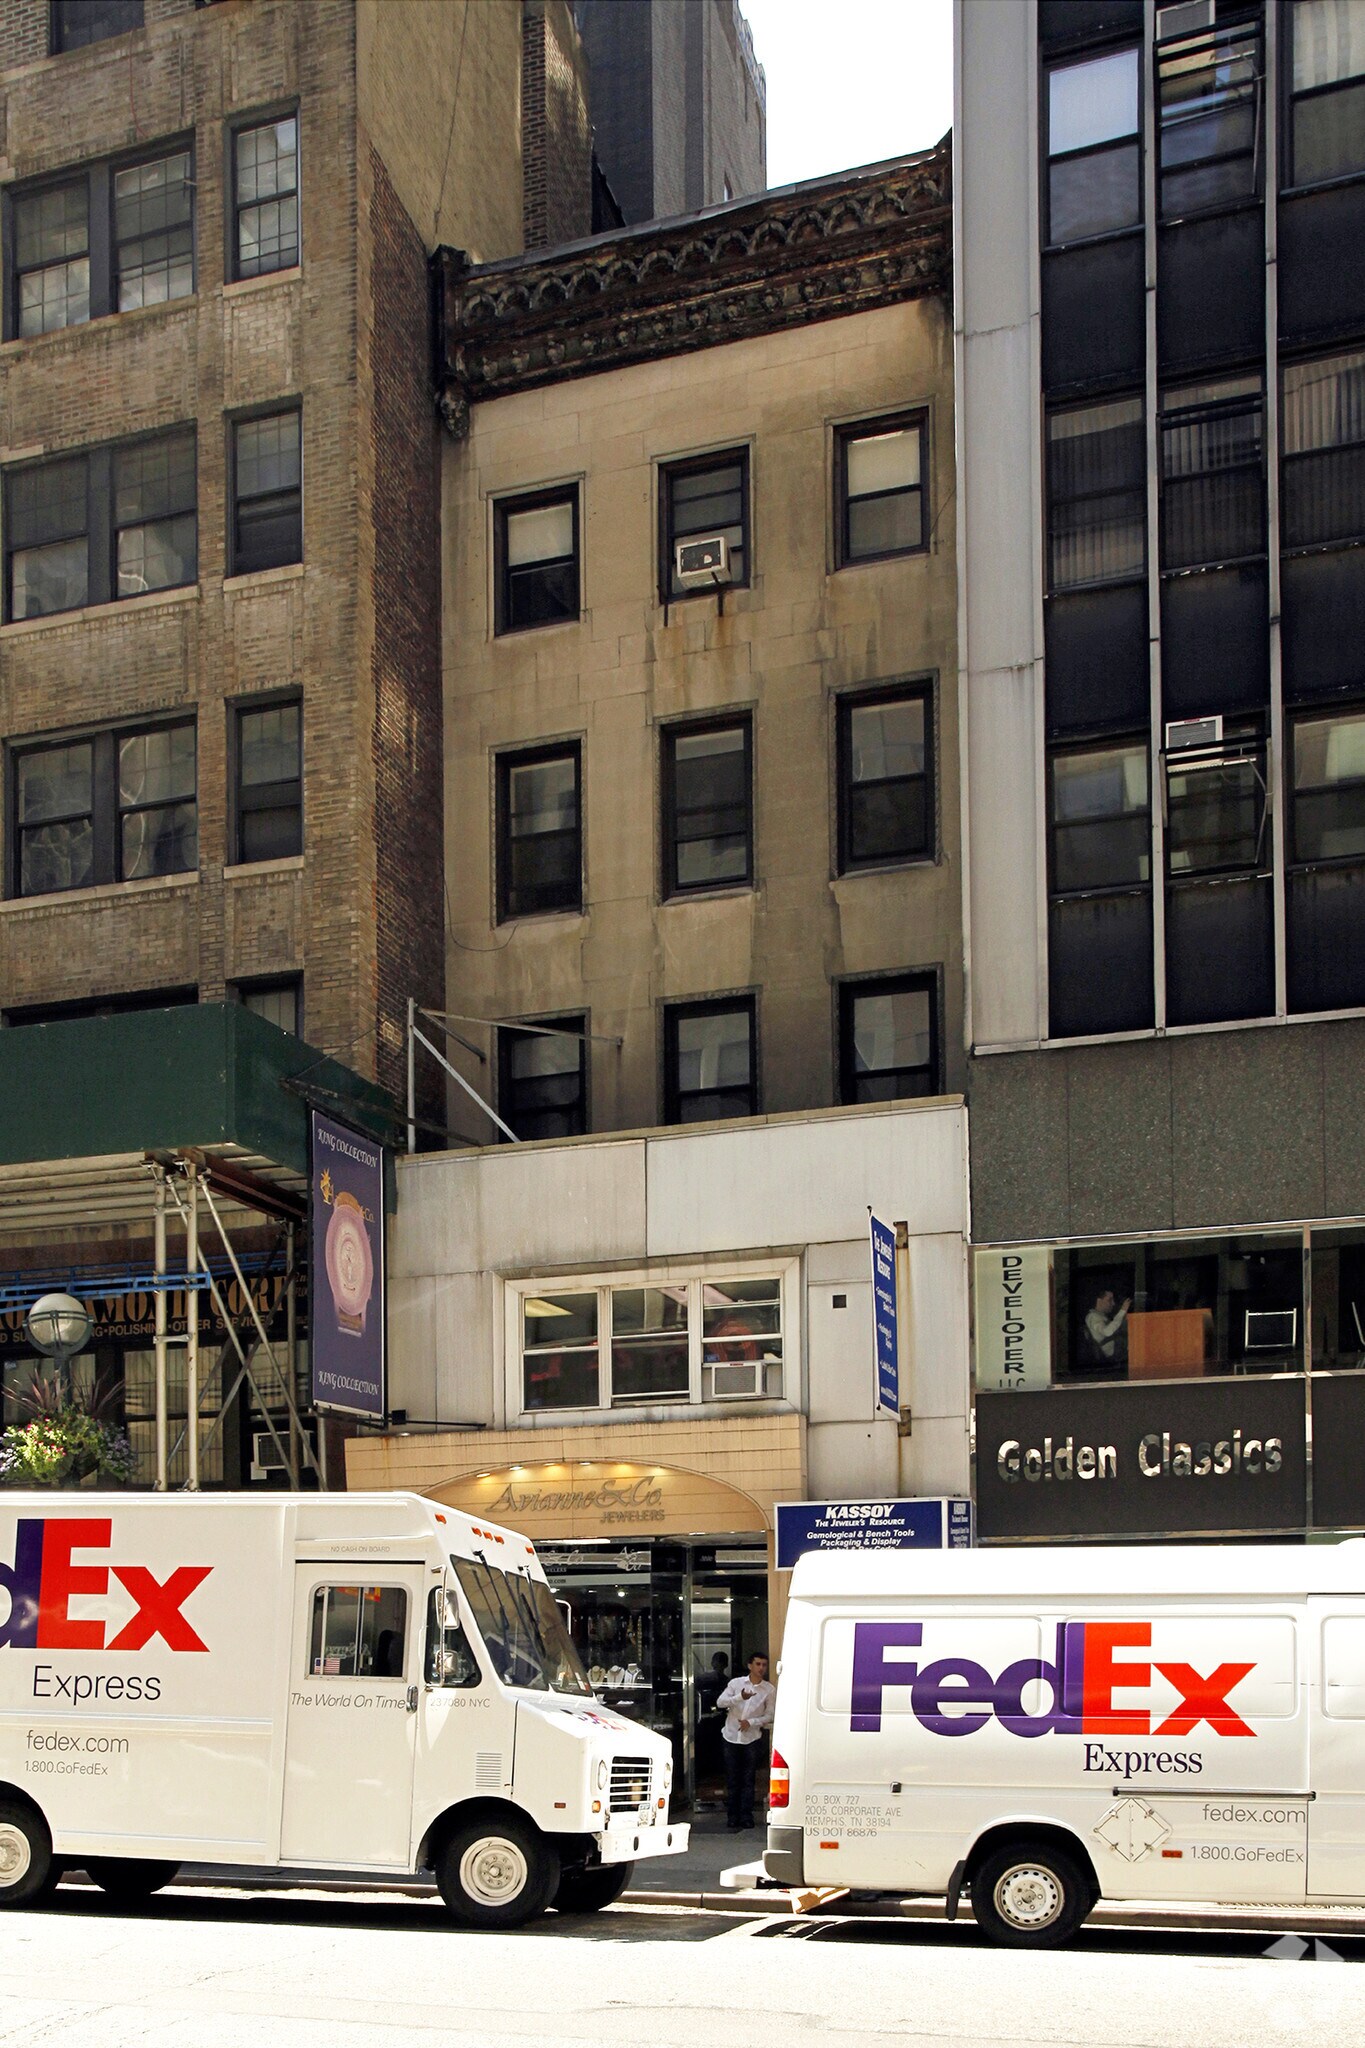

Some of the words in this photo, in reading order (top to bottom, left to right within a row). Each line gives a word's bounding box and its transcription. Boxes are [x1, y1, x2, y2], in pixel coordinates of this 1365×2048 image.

[317, 1128, 336, 1151] KING
[336, 1139, 378, 1168] COLLECTION
[1001, 1255, 1025, 1374] DEVELOPER
[108, 1325, 157, 1337] POLISHIN
[172, 1319, 211, 1333] OTER
[318, 1370, 337, 1390] KING
[337, 1375, 380, 1395] COLLECTION
[997, 1436, 1117, 1483] Golden
[1138, 1429, 1282, 1478] Classics
[600, 1509, 665, 1524] JEWELERS
[825, 1504, 895, 1519] KASSOY
[869, 1518, 905, 1526] RESOURCE
[807, 1531, 855, 1540] Gemological
[866, 1530, 891, 1538] Bench
[893, 1529, 915, 1537] Tools
[820, 1539, 861, 1548] Packaging
[871, 1537, 901, 1546] Display
[33, 1665, 161, 1706] Express
[850, 1622, 1258, 1738] FedEx
[291, 1692, 312, 1706] The
[315, 1693, 351, 1707] World
[354, 1694, 373, 1708] On
[375, 1696, 406, 1709] Time
[469, 1698, 490, 1708] NYC
[26, 1730, 129, 1753] fedex.com
[24, 1760, 108, 1776] 1.800.GoFedEx
[1083, 1743, 1203, 1779] Express
[824, 1795, 841, 1805] BOX
[846, 1795, 860, 1805] 727
[805, 1805, 827, 1815] 2005
[831, 1806, 881, 1817] CORPORATE
[1202, 1804, 1306, 1823] fedex.com
[851, 1817, 862, 1827] TN
[866, 1818, 891, 1827] 38194
[805, 1827, 819, 1837] US
[823, 1828, 844, 1837] DOT
[847, 1828, 877, 1838] 86876
[1191, 1846, 1304, 1863] 1.800.GoFedEx
